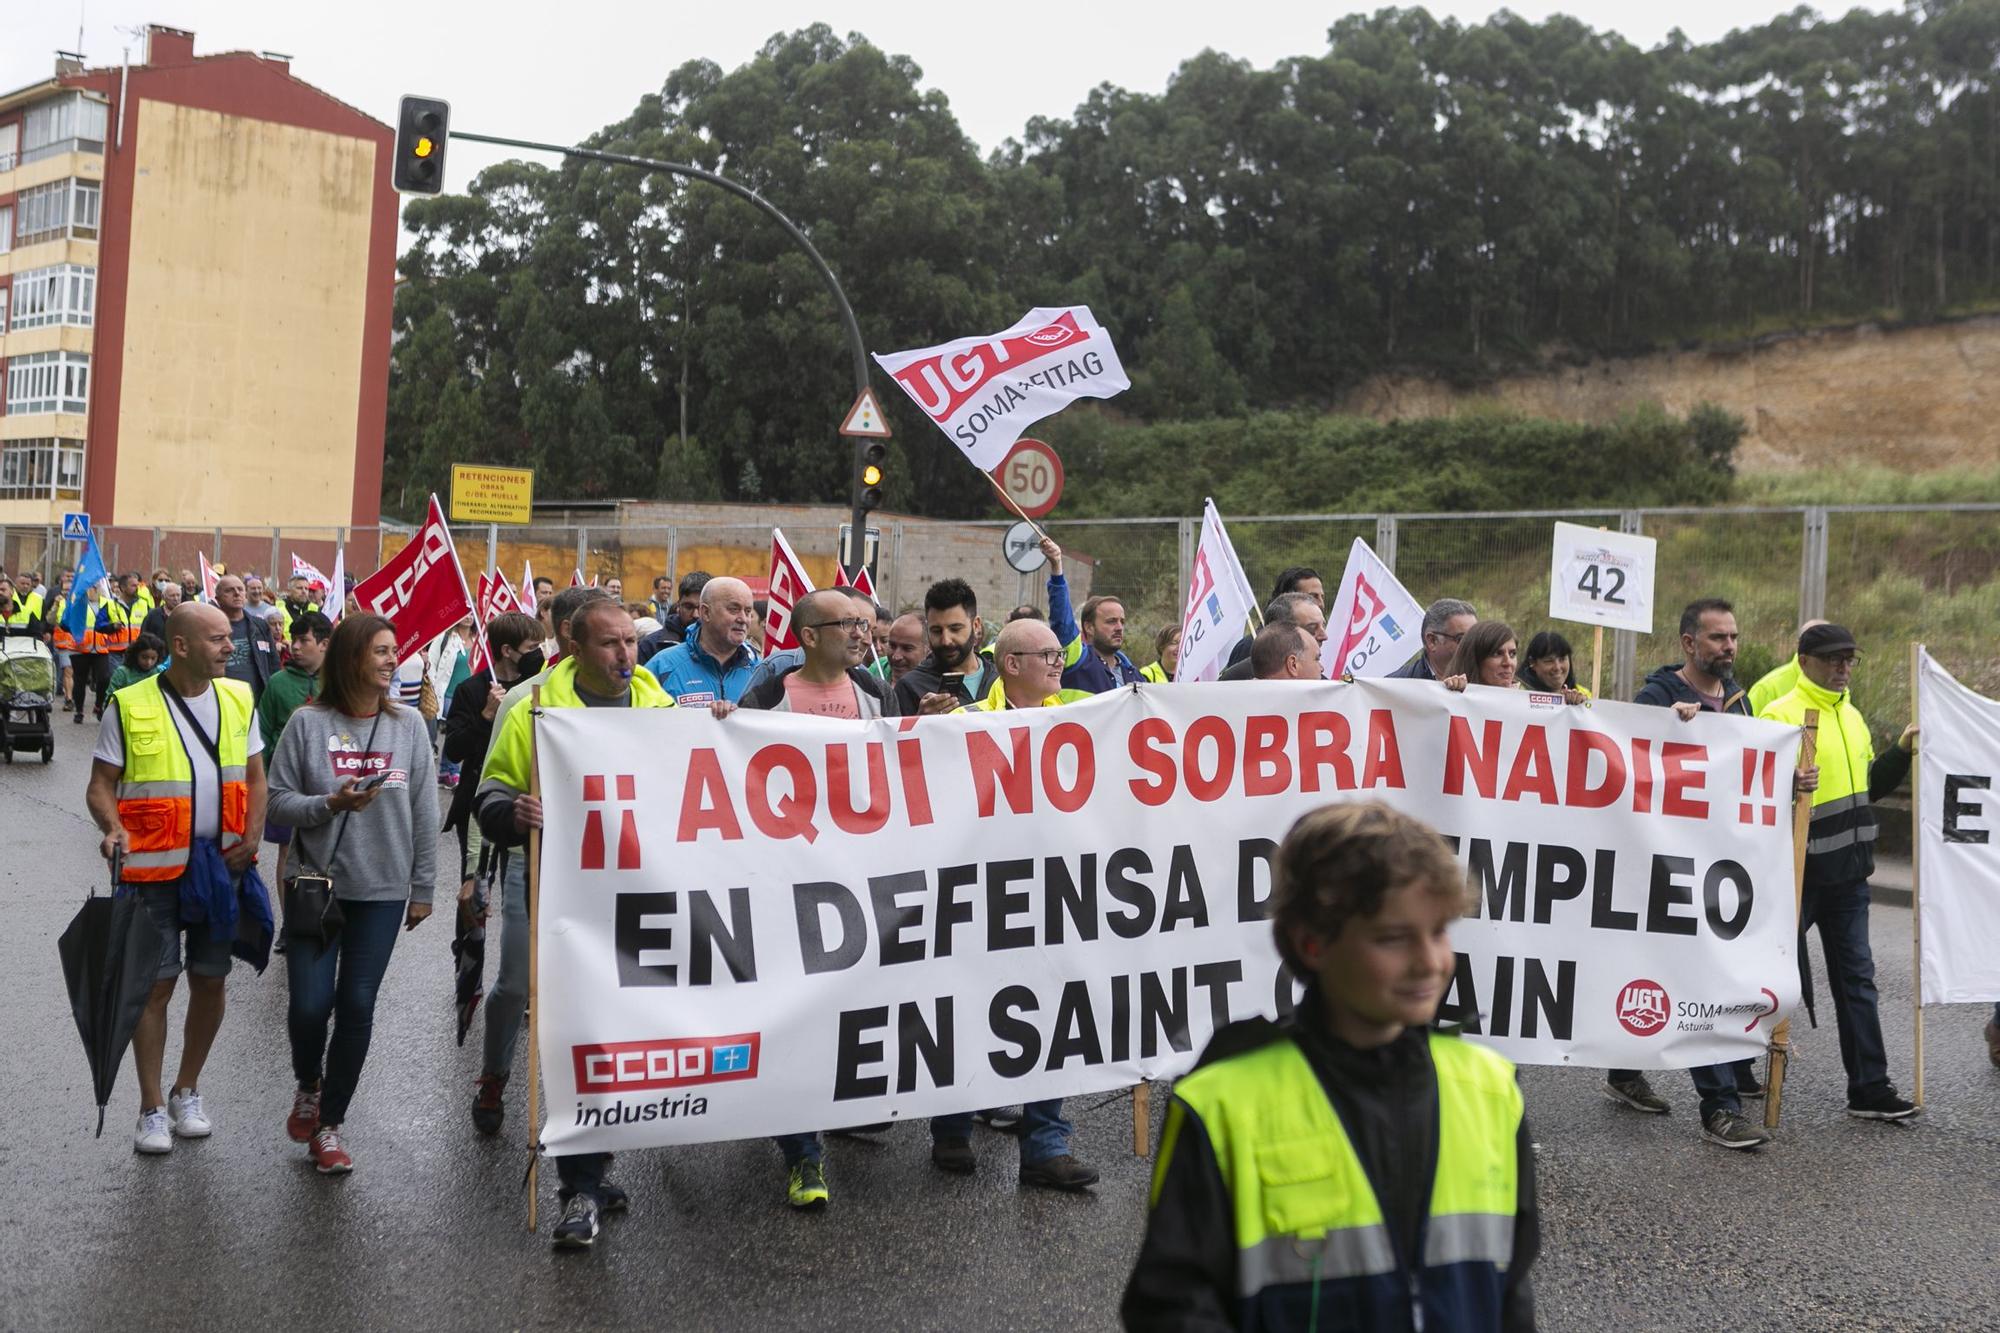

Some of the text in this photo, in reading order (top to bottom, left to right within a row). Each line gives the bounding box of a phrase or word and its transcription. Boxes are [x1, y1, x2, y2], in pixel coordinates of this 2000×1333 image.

[900, 340, 1010, 417] UGT
[956, 384, 1027, 448] SOMA
[459, 472, 526, 485] RETENCIONES
[1011, 463, 1049, 494] 50
[490, 503, 528, 511] ALTERNATIVO
[491, 492, 519, 501] MUELLE
[469, 509, 513, 517] RECOMENDADO
[1577, 564, 1626, 605] 42
[396, 631, 420, 658] TURIAS
[681, 695, 704, 703] CCOO
[1531, 695, 1552, 704] CCOO
[676, 715, 935, 844] AQUÍ
[965, 722, 1096, 818] NO
[1128, 709, 1406, 806] SOBRA
[1442, 714, 1709, 820] NADIE
[614, 886, 757, 988] EN
[792, 844, 1209, 976] DEFENSA
[1444, 835, 1753, 941] MPLEO
[1621, 987, 1665, 1013] UGT
[1677, 1001, 1723, 1019] SOMA
[833, 996, 954, 1102] EN
[988, 959, 1243, 1078] SAINT
[1677, 1021, 1714, 1032] Asturias
[584, 1046, 706, 1084] CCOO
[575, 1093, 708, 1128] industria
